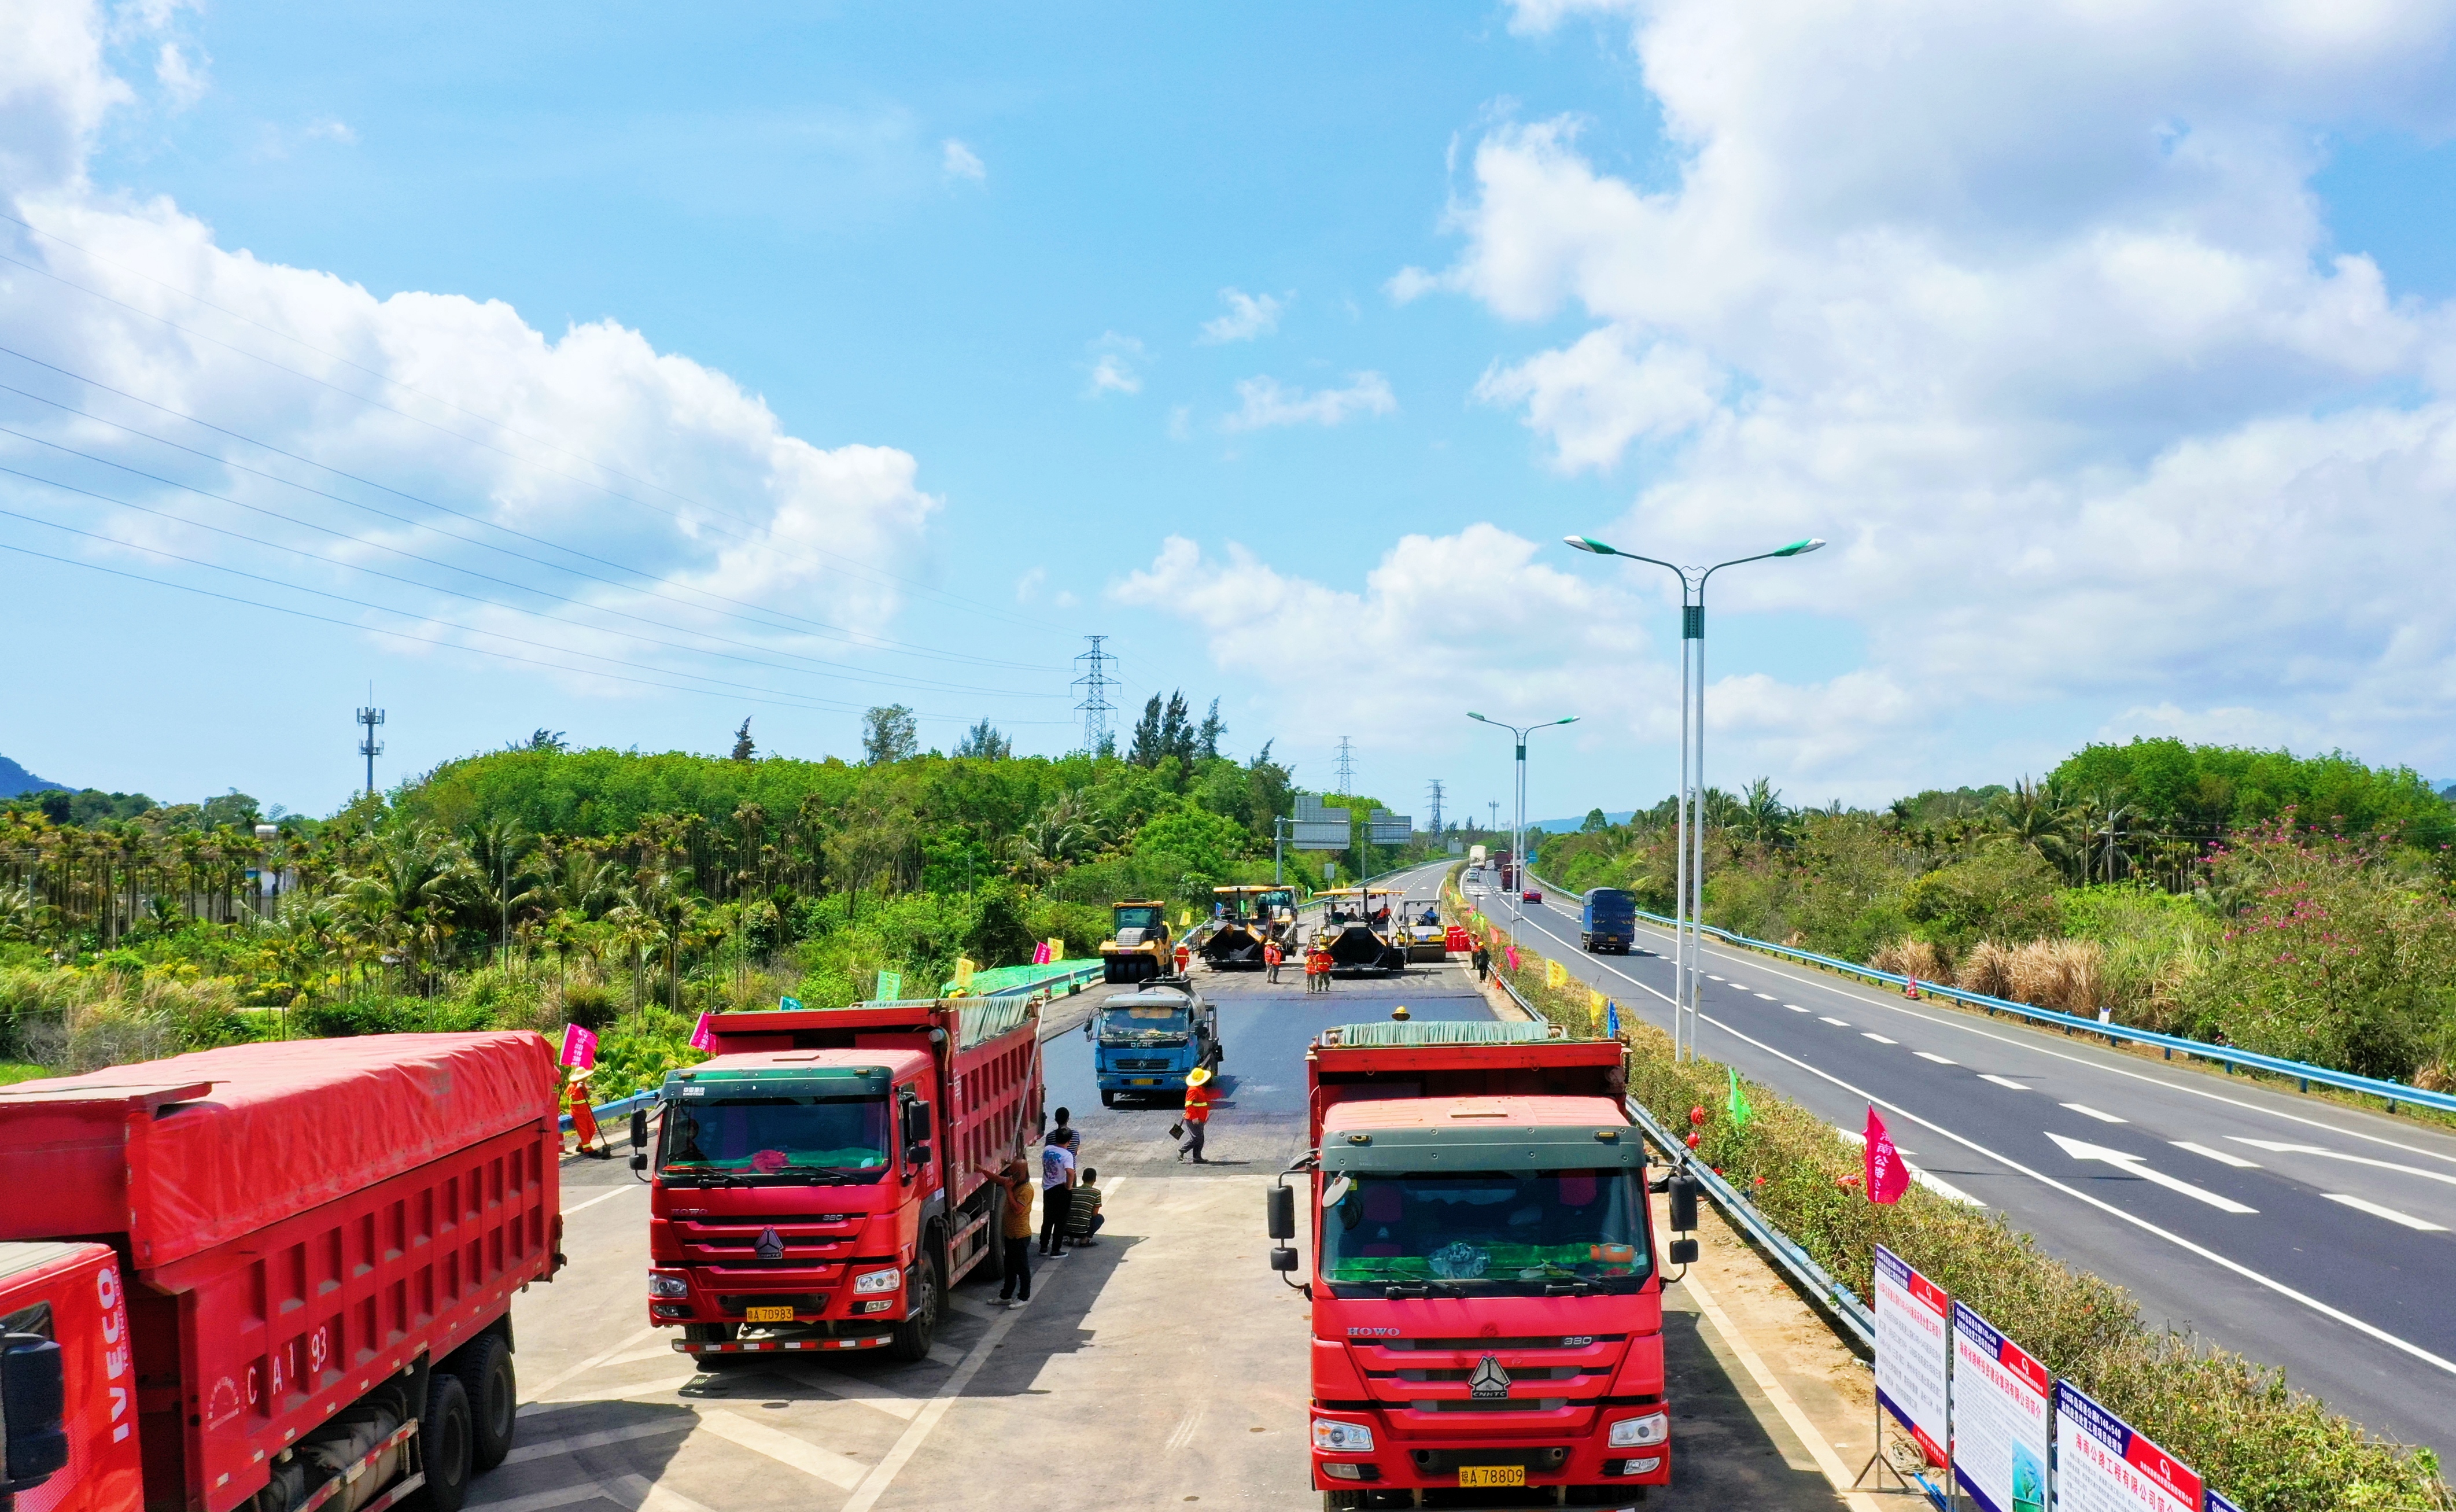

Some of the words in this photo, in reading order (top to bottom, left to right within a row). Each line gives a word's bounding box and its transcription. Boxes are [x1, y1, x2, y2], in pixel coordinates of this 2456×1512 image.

[1347, 1327, 1400, 1336] HOWO
[1564, 1337, 1592, 1345] 380
[97, 1268, 130, 1443] IVECO
